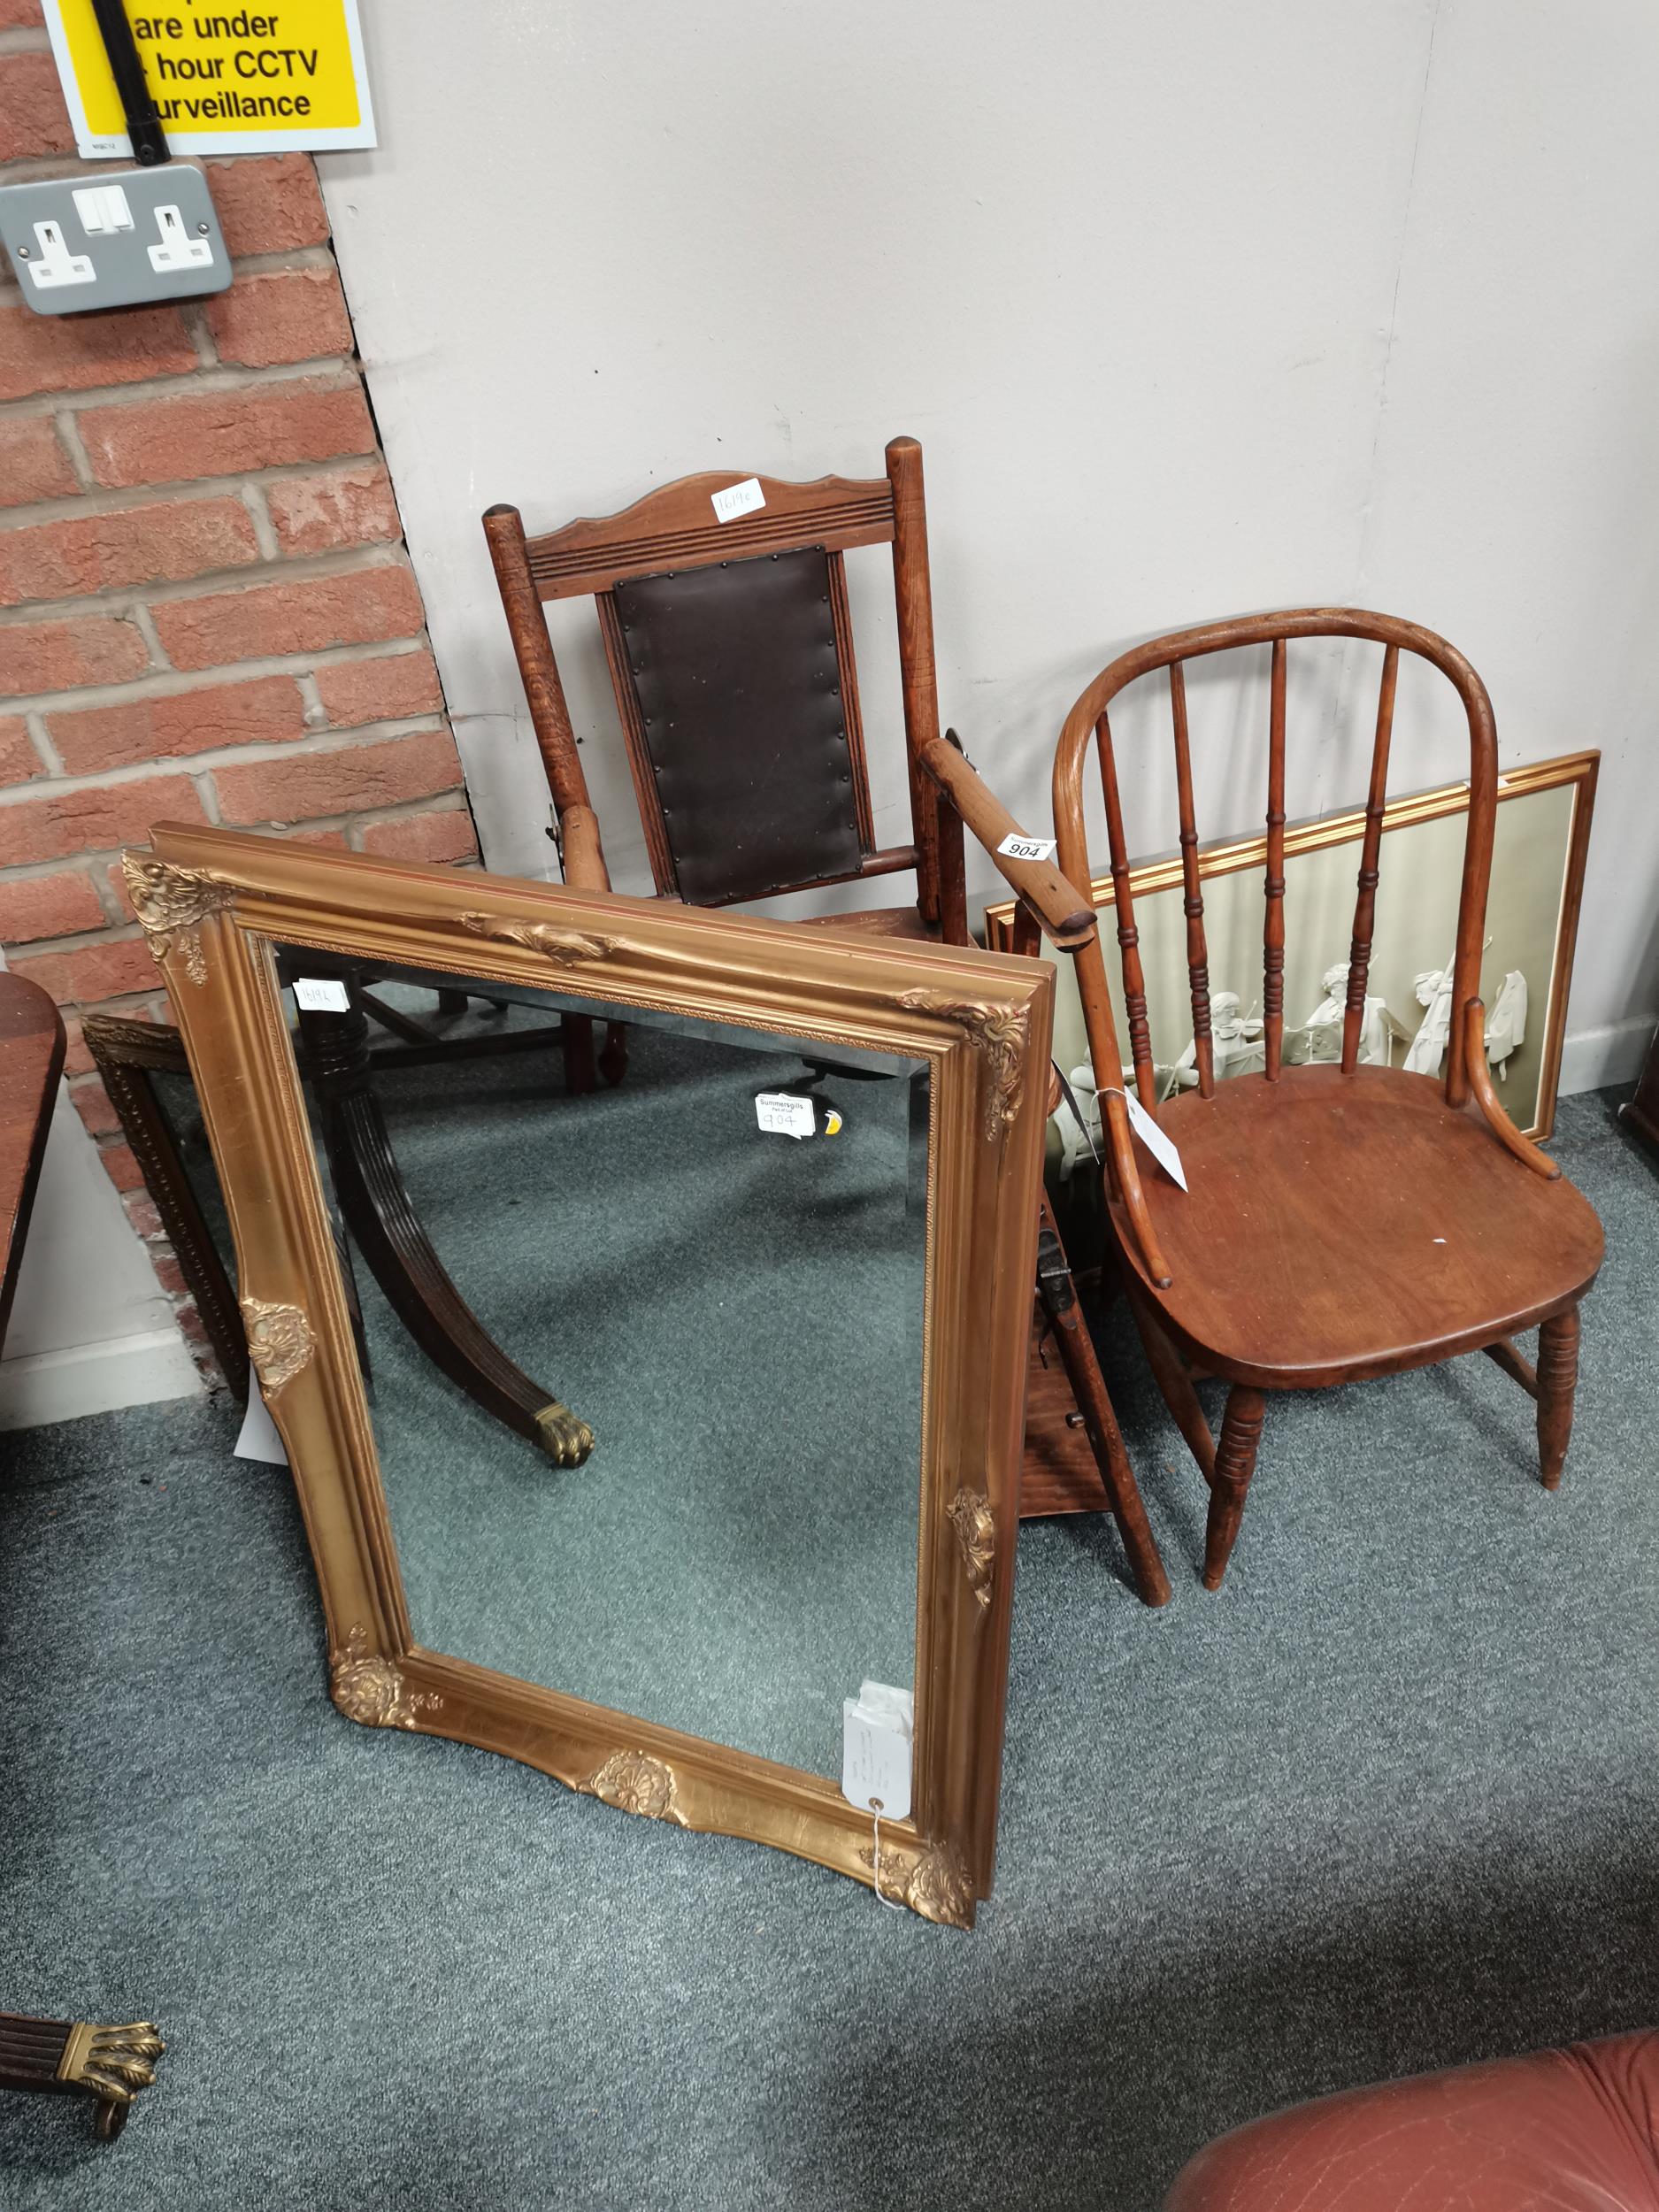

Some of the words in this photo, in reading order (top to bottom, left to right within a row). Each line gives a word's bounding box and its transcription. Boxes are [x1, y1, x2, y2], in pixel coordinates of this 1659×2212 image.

[134, 17, 183, 40] are
[194, 10, 279, 39] under
[157, 51, 225, 81] hour
[234, 49, 319, 79] CCTV
[152, 91, 311, 119] urveillance
[1009, 844, 1041, 857] 904
[760, 1098, 803, 1110] Summersgills
[764, 1115, 796, 1127] 904
